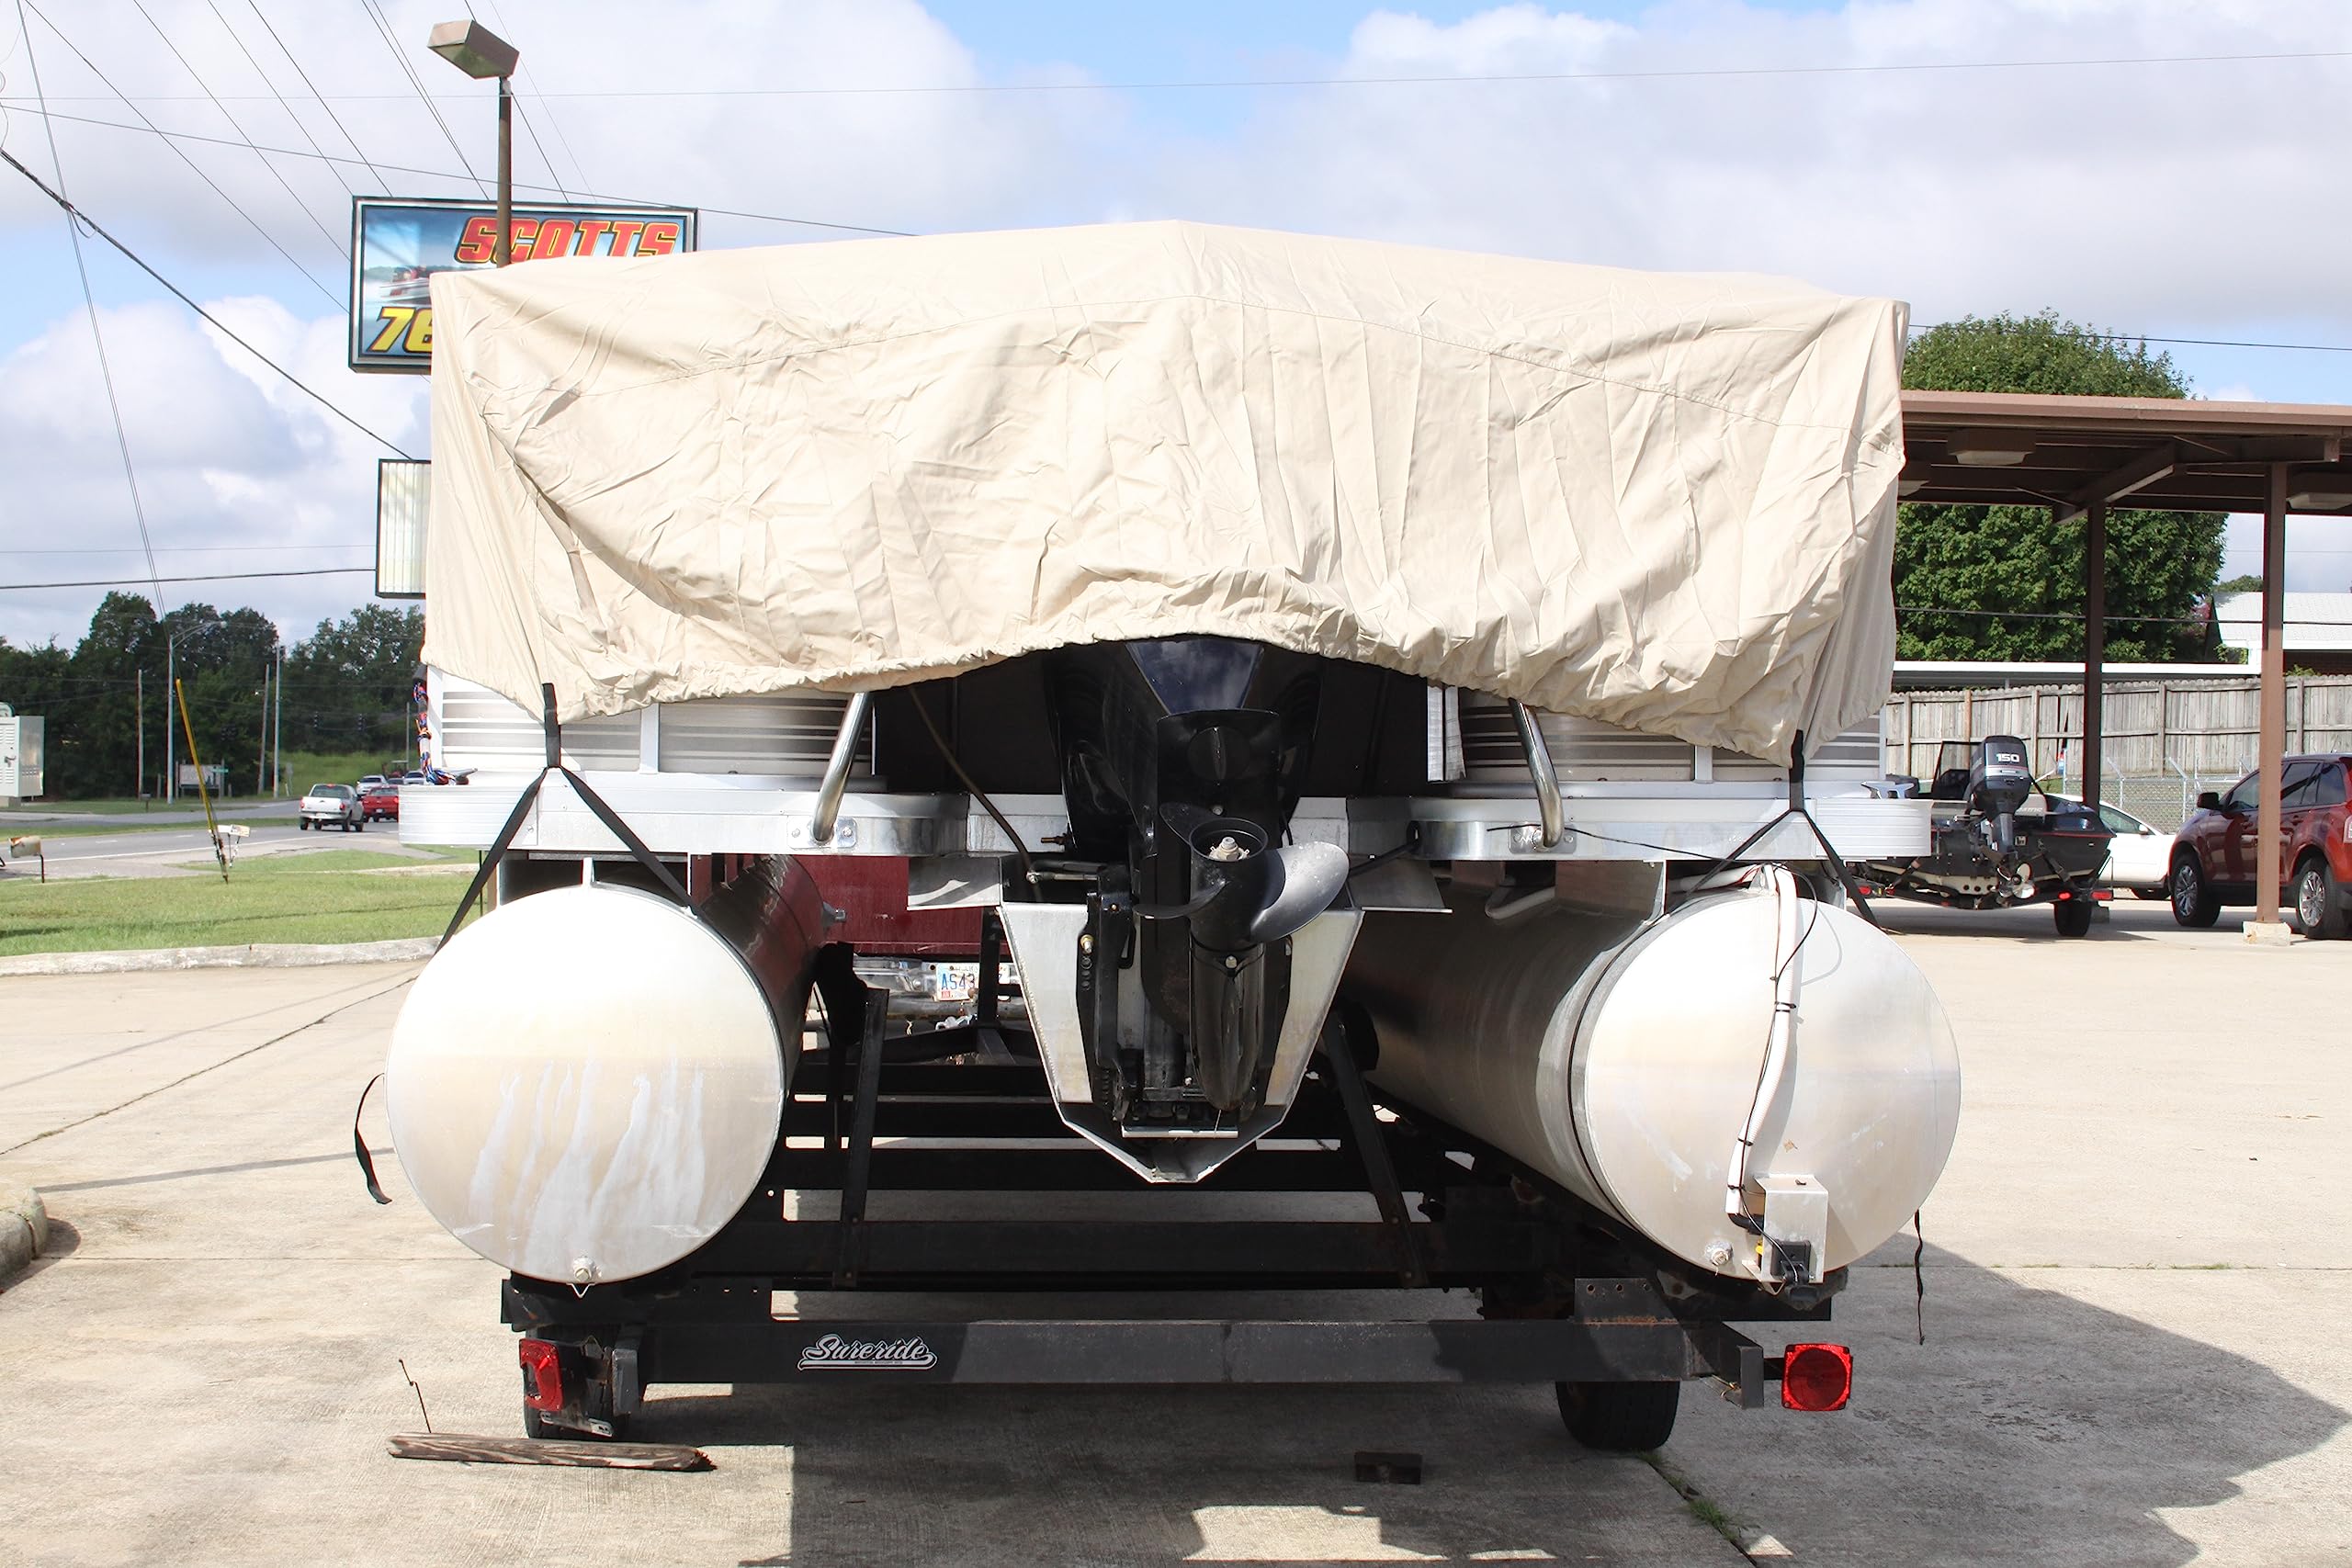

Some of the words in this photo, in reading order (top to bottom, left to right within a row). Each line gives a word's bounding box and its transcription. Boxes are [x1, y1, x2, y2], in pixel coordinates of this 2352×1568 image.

[455, 217, 680, 264] SCOTTS
[1996, 753, 2019, 762] 150
[799, 1334, 937, 1367] Sureride
